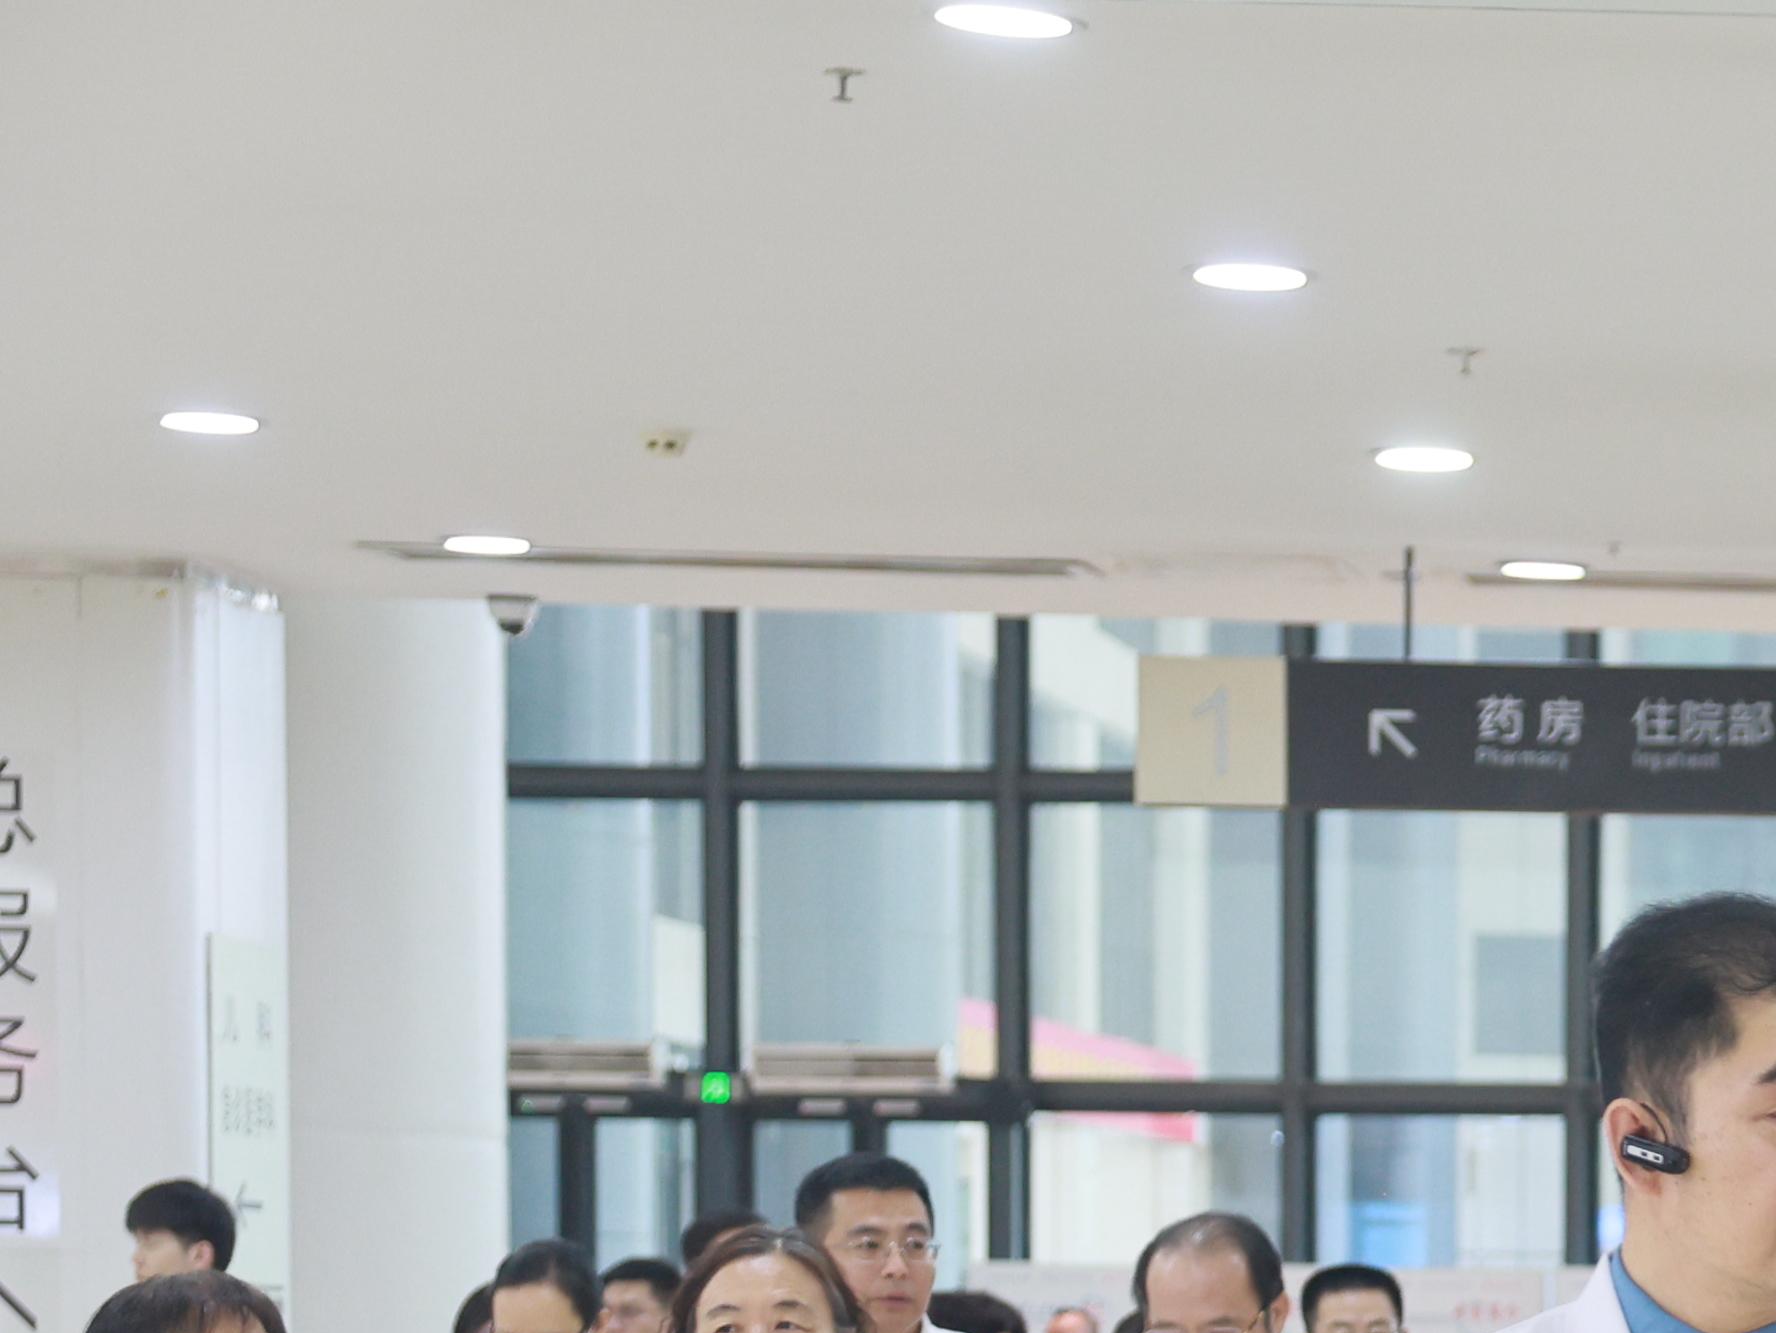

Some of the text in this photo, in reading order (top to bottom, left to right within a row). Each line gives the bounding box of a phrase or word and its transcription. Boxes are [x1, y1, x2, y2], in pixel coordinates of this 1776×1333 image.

[1190, 685, 1235, 777] 1
[1475, 695, 1585, 747] 药房
[1632, 697, 1776, 747] 住院部
